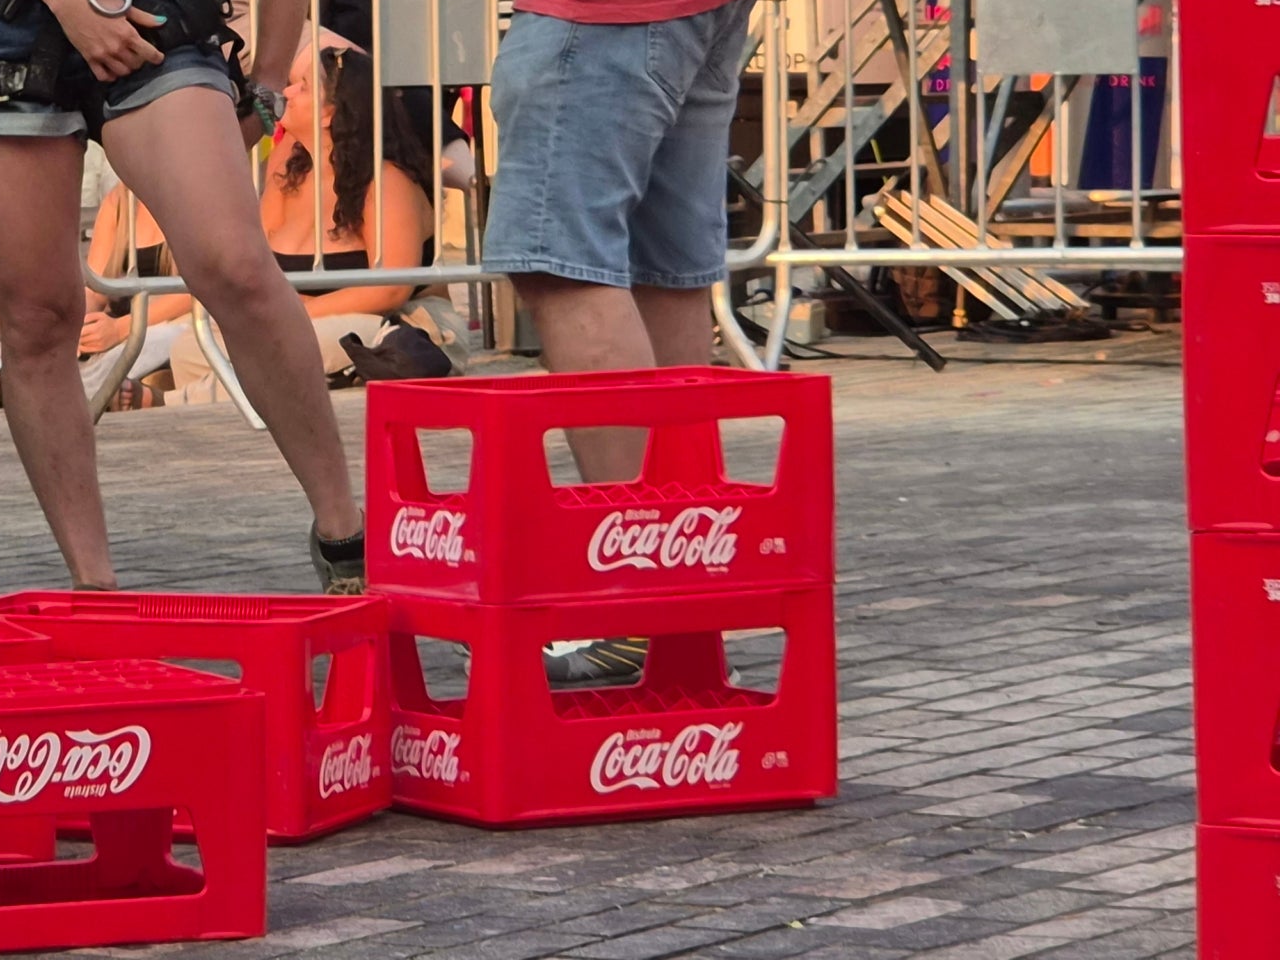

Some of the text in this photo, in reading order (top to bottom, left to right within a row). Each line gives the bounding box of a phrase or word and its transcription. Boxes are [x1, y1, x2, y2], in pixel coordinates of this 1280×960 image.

[1109, 74, 1156, 88] DRNK
[587, 505, 743, 572] Coca-Cola
[590, 721, 744, 794] Coca-Cola
